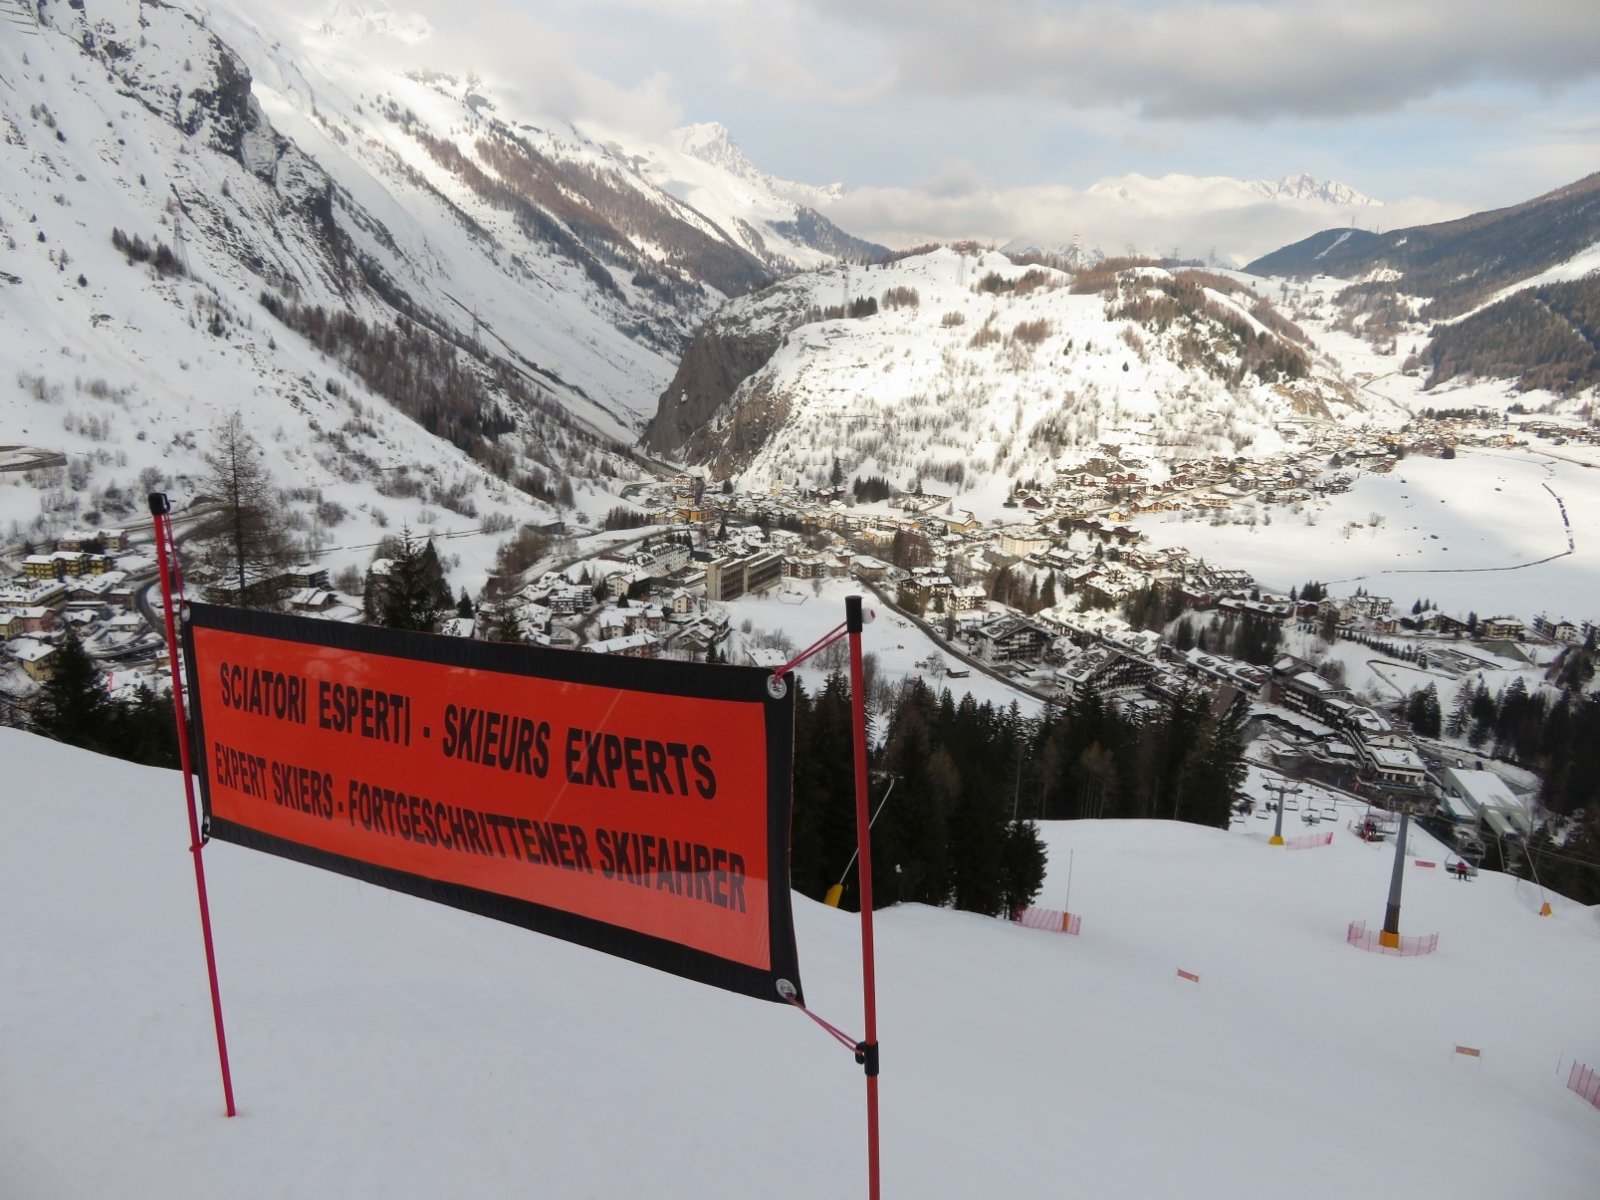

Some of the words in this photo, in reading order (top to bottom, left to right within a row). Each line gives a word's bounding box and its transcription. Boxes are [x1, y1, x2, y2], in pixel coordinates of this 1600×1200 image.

[220, 662, 307, 725] SCIATORI
[319, 681, 411, 747] ESPERTI
[443, 704, 550, 779] SKIEURS
[565, 727, 717, 800] EXPERTS
[215, 742, 267, 800] EXPERT
[271, 760, 334, 821] SKIERS
[349, 780, 593, 875] FORTGESCHRITTENER
[595, 827, 746, 914] SKIFAHRER
